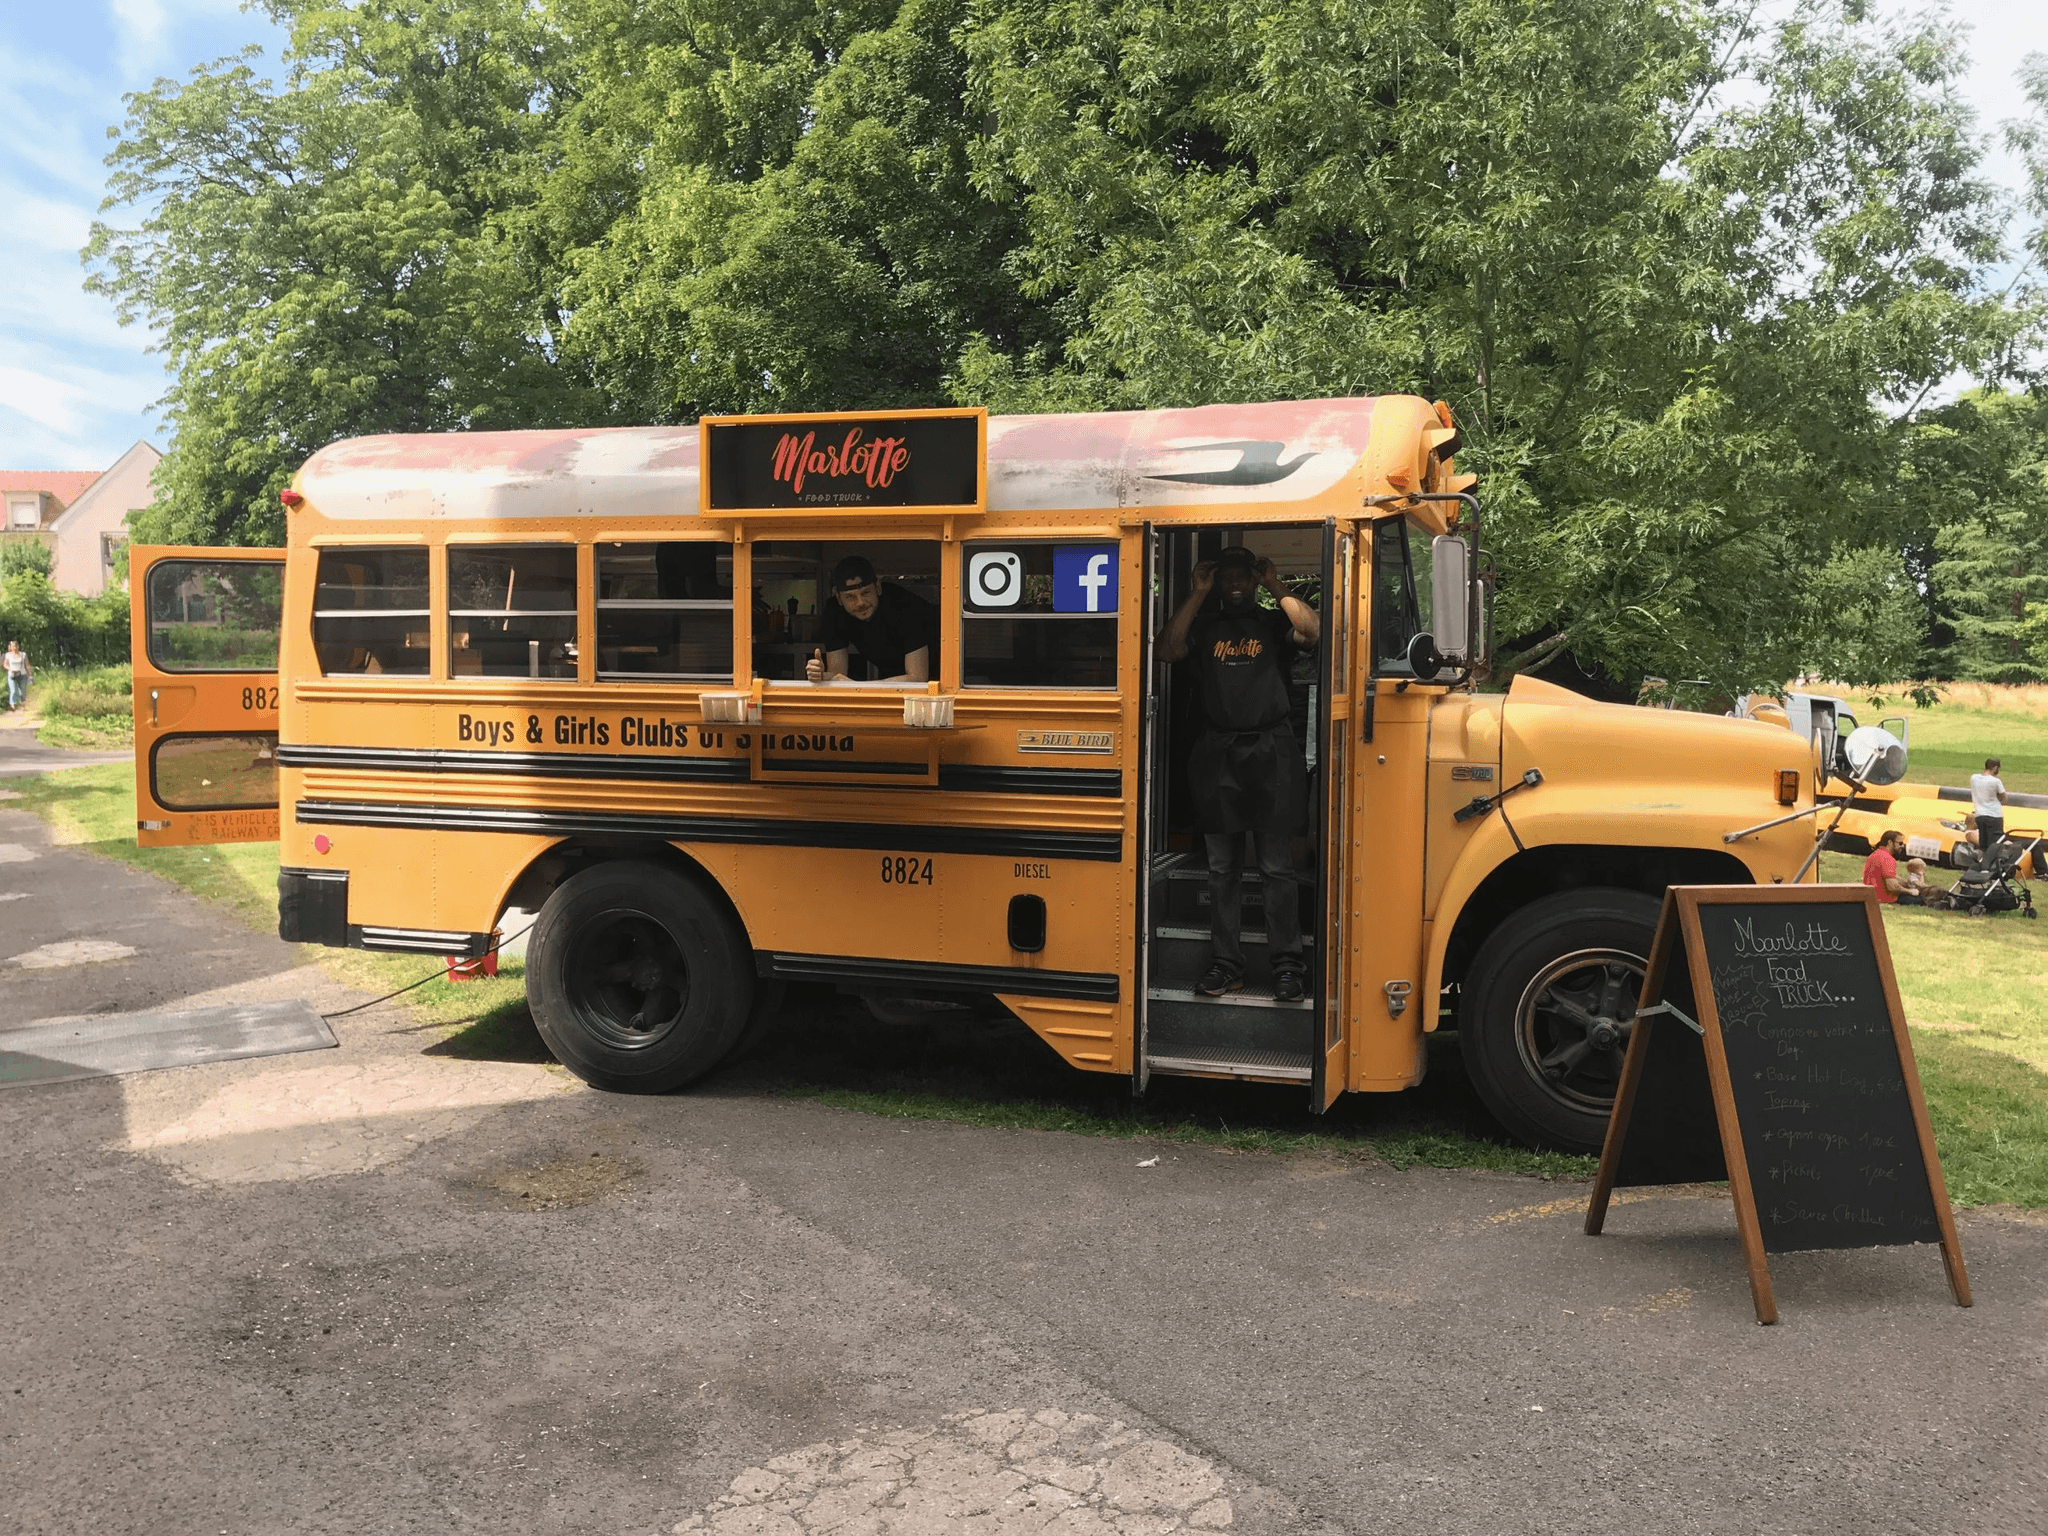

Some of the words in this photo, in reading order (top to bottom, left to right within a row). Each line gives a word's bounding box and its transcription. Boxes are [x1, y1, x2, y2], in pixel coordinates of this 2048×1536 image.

[771, 427, 911, 494] Marlotte
[805, 494, 831, 502] FOOD
[834, 493, 863, 502] TRUCK
[1078, 554, 1109, 612] f
[458, 714, 515, 747] Boys
[525, 714, 543, 744] &
[555, 715, 610, 746] Girls
[620, 717, 688, 748] Clubs
[1041, 733, 1073, 746] BLUE
[1077, 734, 1110, 746] BIRD
[881, 856, 934, 885] 8824
[1014, 863, 1051, 878] DIESEL
[1734, 916, 1847, 952] Marlotte
[1767, 958, 1807, 982] Food
[1808, 1064, 1831, 1083] Hot
